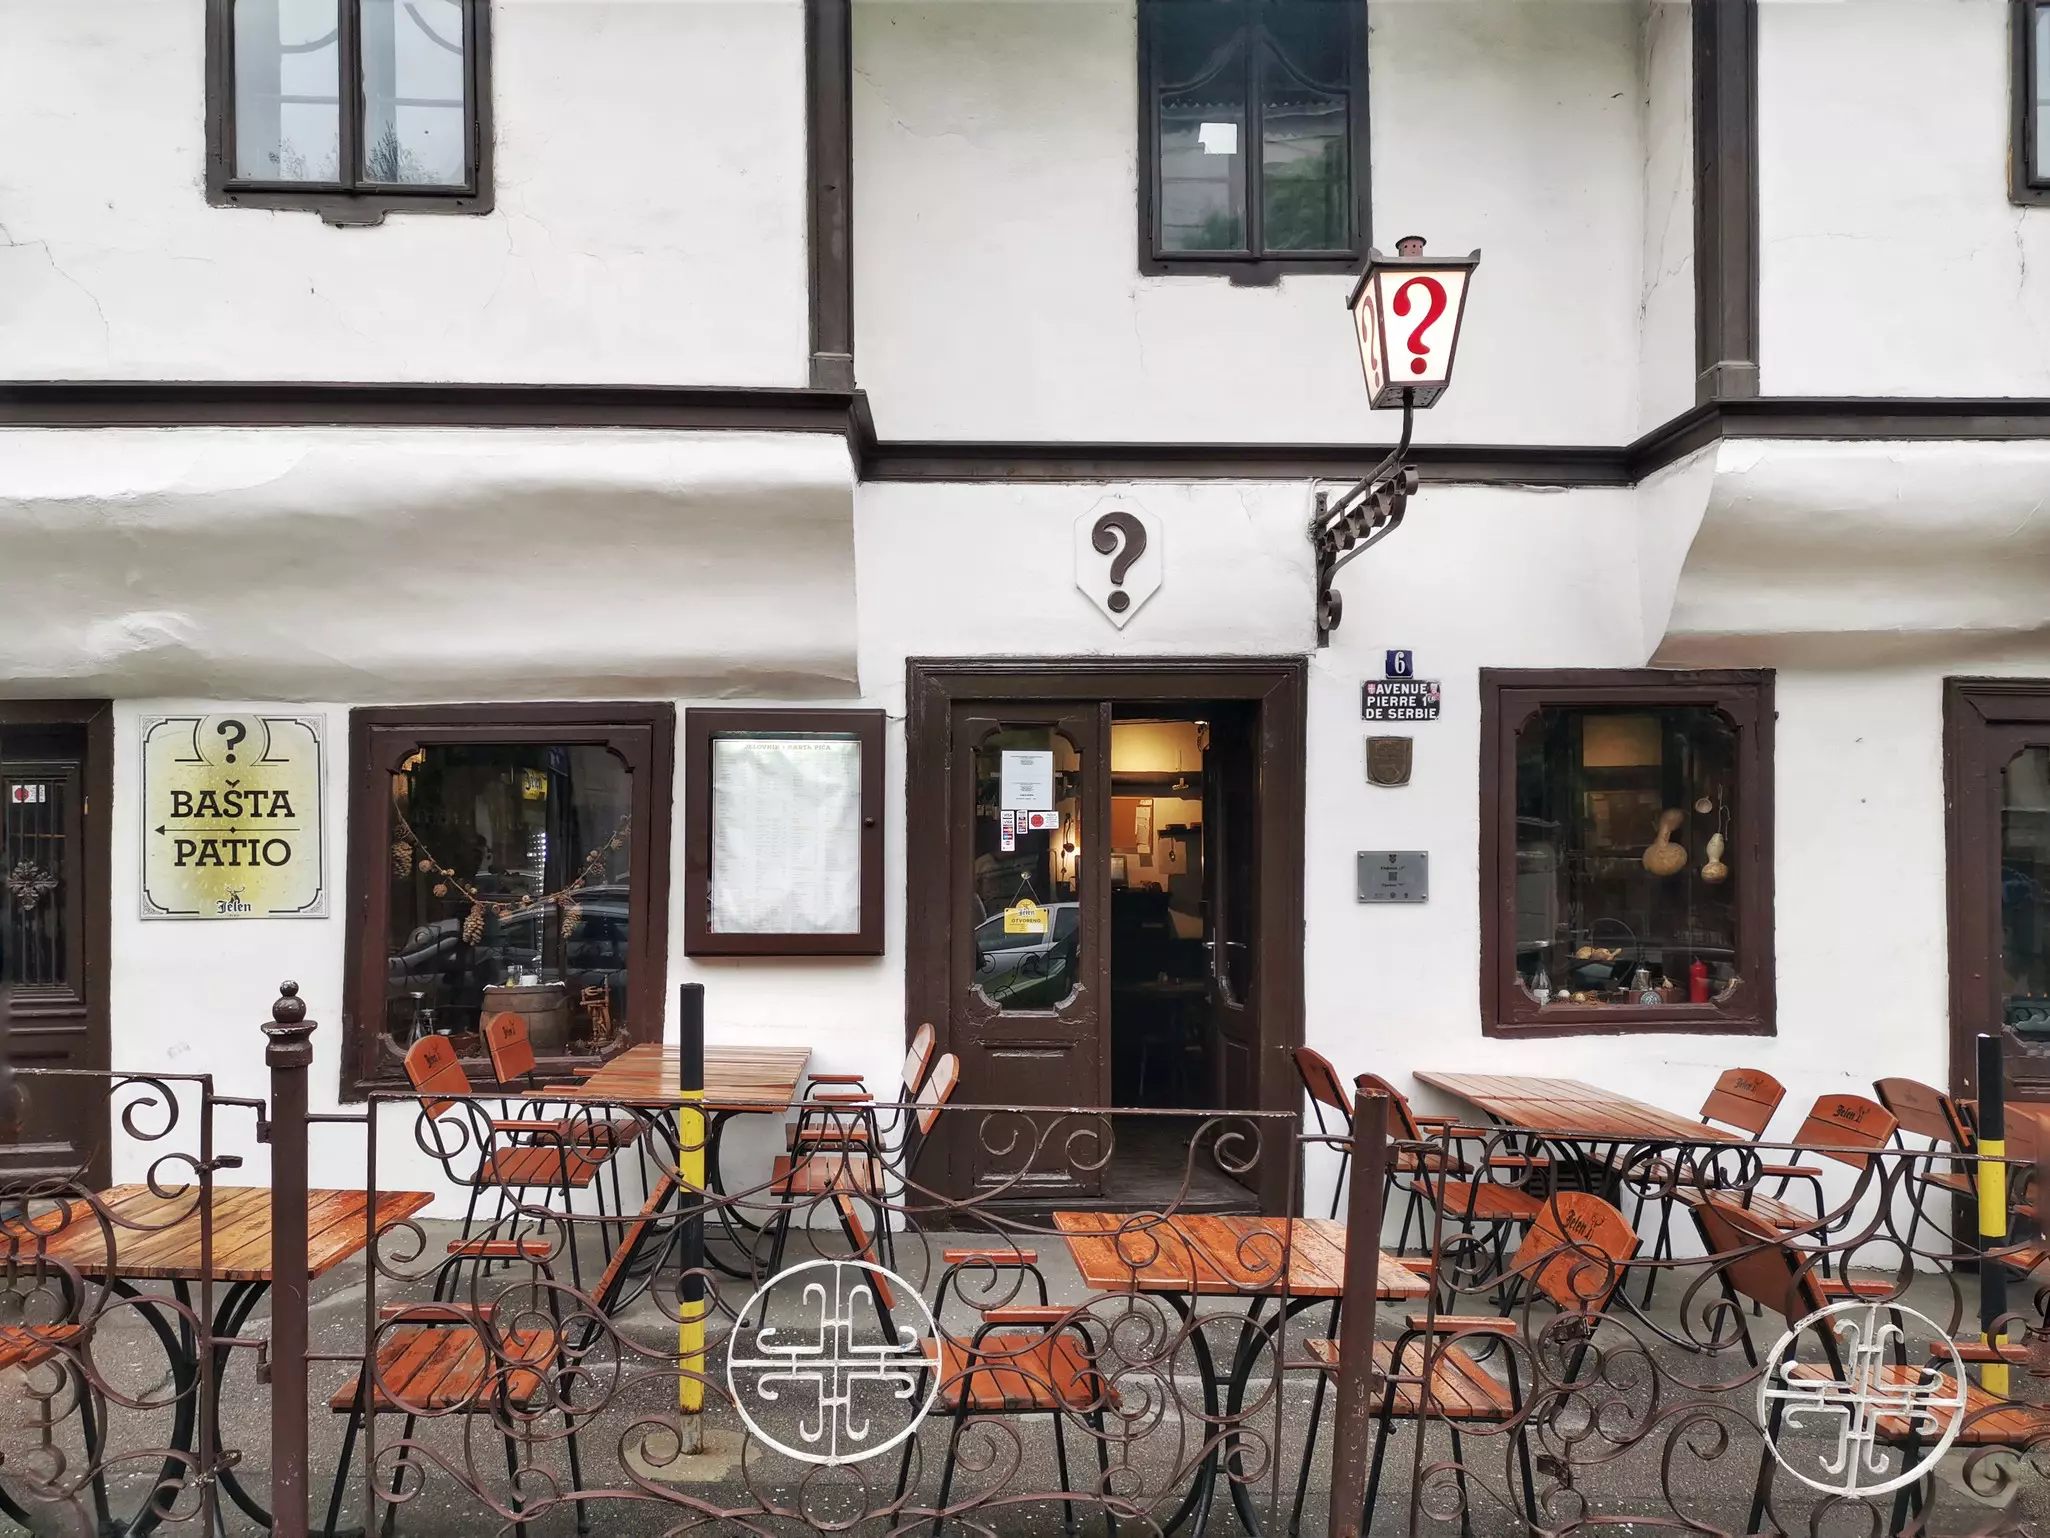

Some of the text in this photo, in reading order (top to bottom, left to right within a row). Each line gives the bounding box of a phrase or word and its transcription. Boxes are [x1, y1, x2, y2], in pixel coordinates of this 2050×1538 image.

[1393, 276, 1447, 375] ?
[1092, 511, 1147, 613] ?
[1394, 651, 1406, 674] 6
[1367, 696, 1417, 707] PIERRE
[1375, 683, 1428, 695] AVENUE
[1366, 708, 1437, 719] DE SERBIE
[217, 719, 246, 764] ?
[170, 779, 295, 818] BAŠTA
[174, 838, 292, 867] PATIO
[216, 900, 252, 914] Jelen
